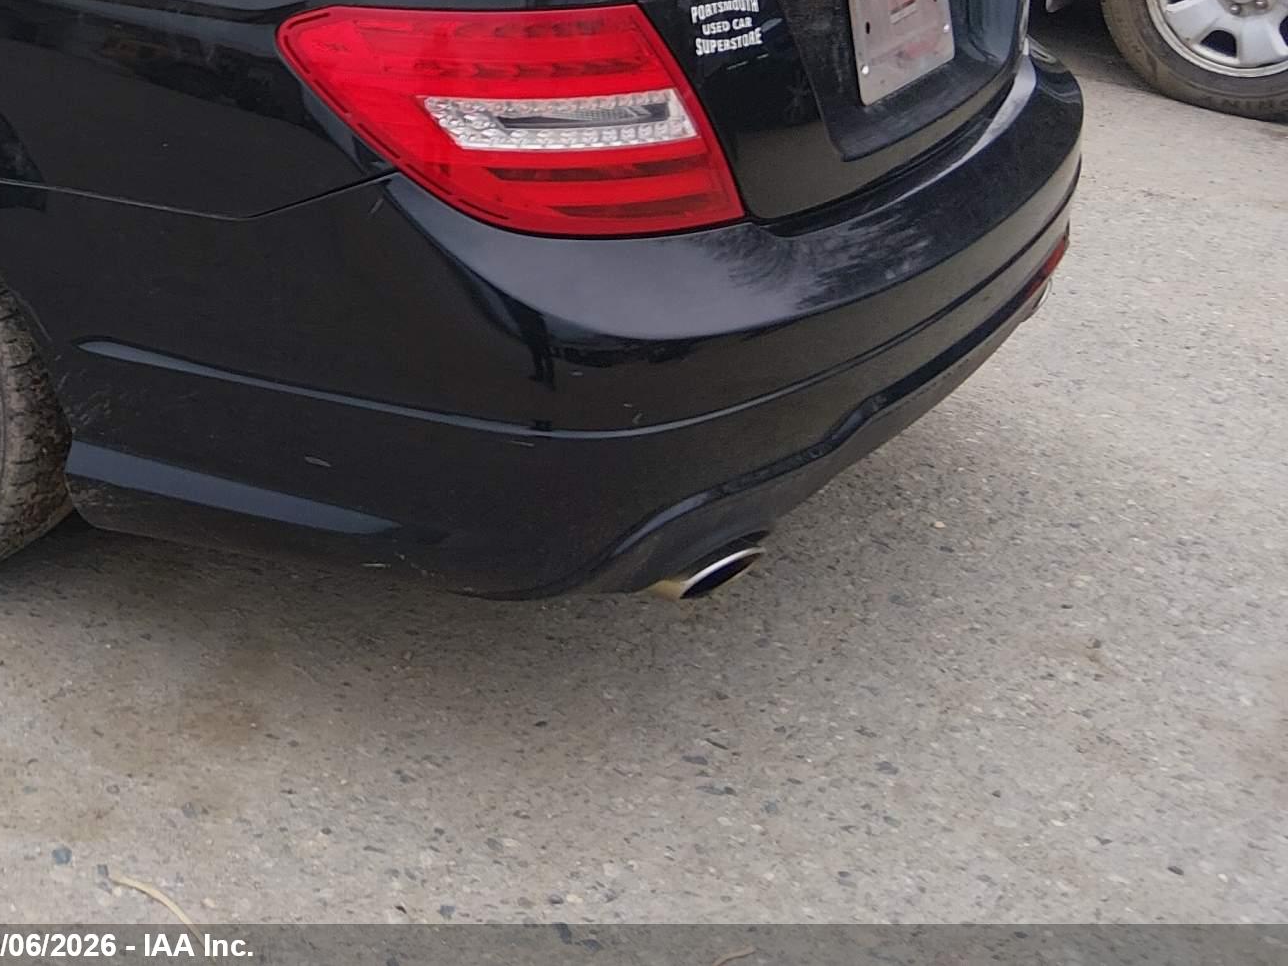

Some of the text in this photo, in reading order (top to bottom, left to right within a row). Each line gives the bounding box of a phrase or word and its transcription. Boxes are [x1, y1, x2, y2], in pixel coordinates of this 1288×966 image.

[702, 16, 753, 36] USED CAR
[695, 27, 764, 56] SUPERSTORE
